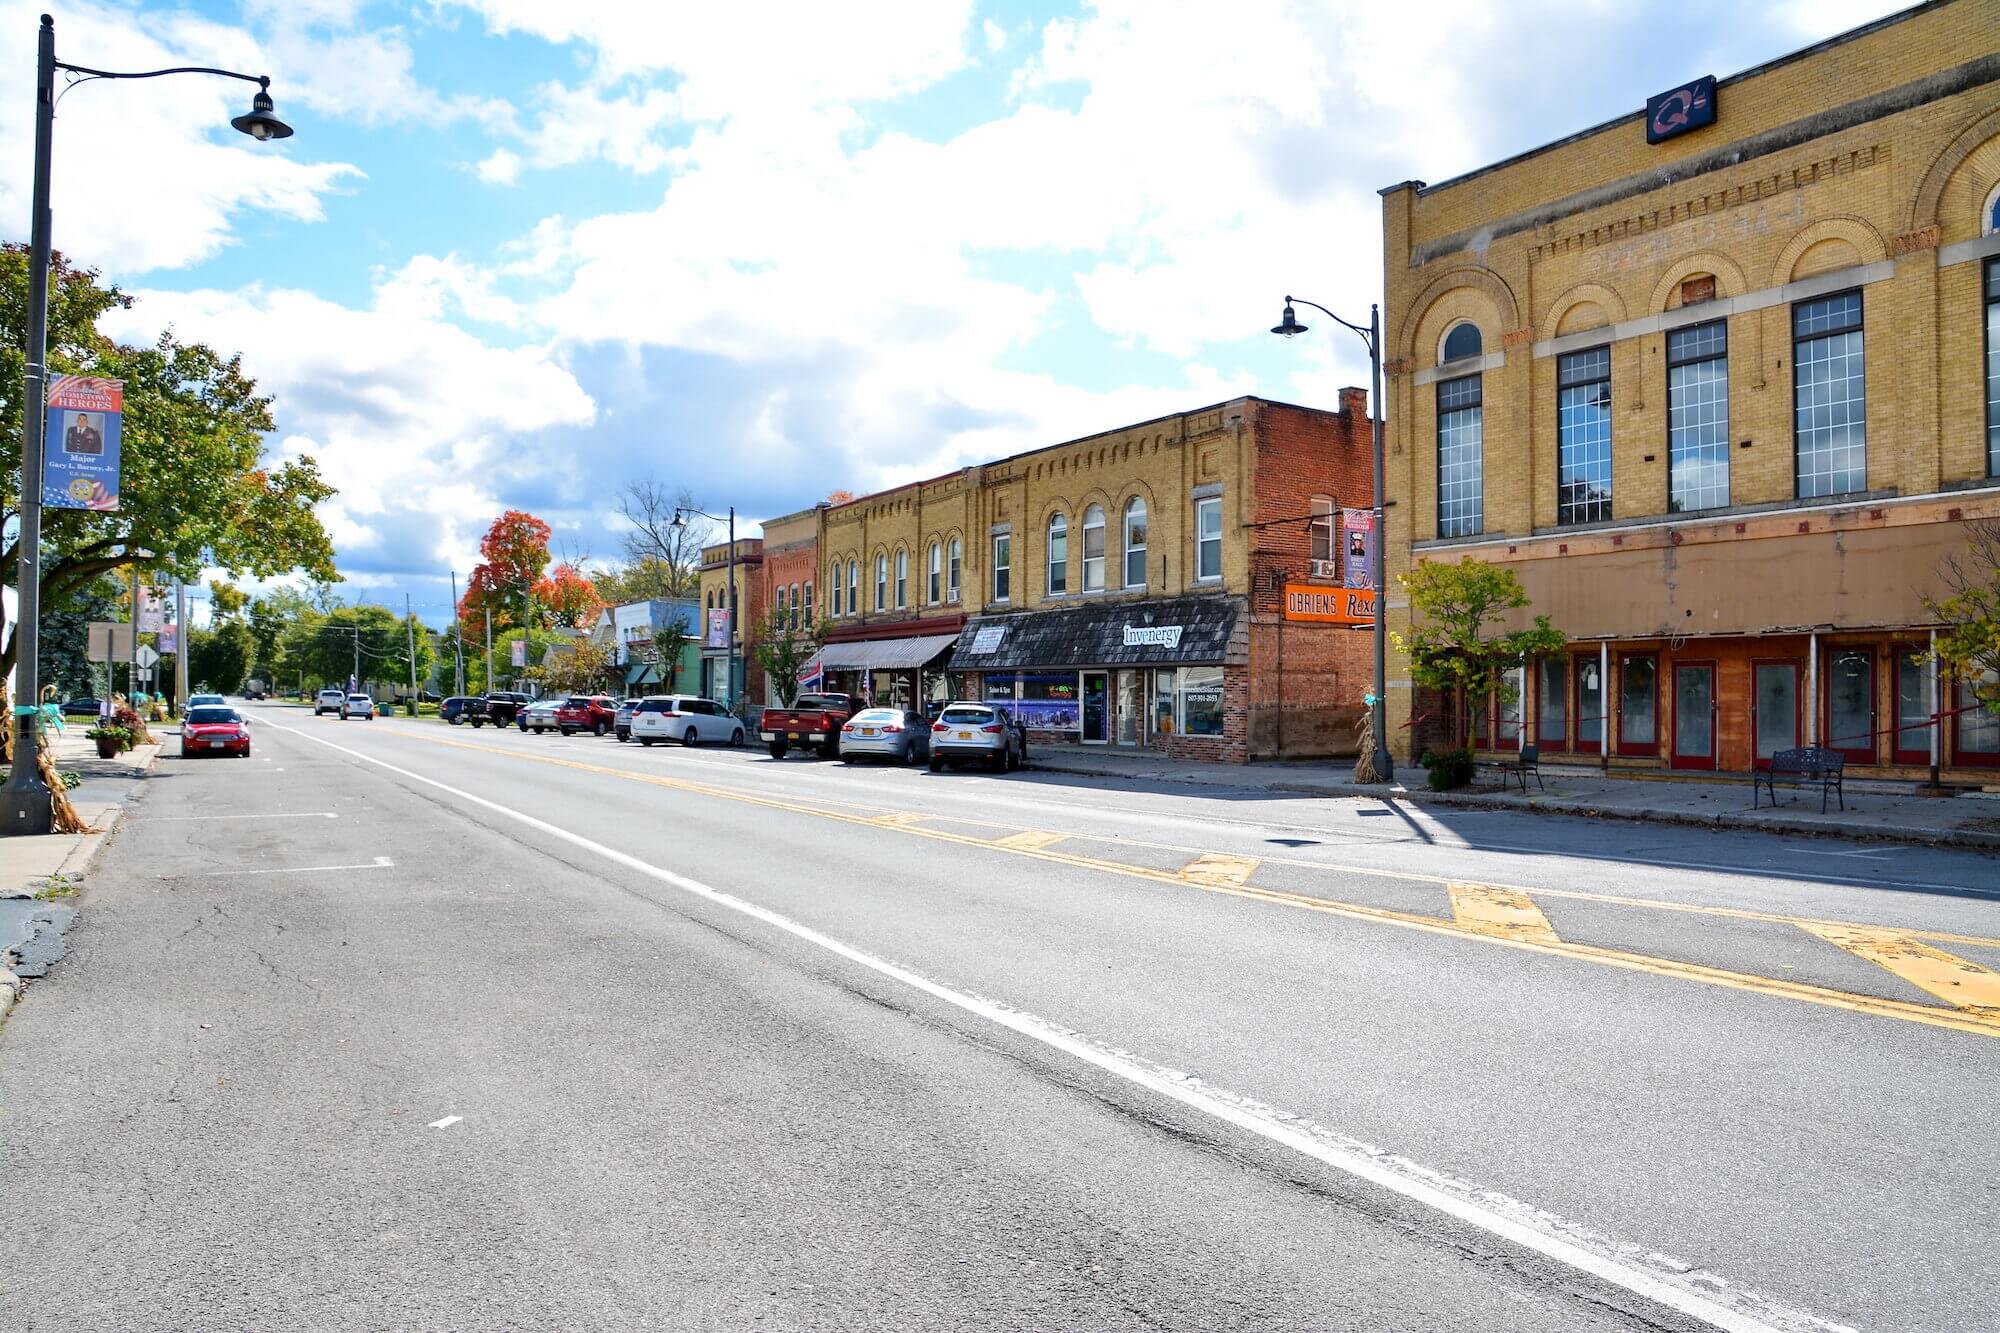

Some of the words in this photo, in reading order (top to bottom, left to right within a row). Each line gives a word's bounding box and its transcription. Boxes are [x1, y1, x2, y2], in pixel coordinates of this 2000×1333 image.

[58, 397, 113, 409] HEROES
[70, 454, 97, 463] Major
[48, 461, 67, 469] Gary
[1289, 593, 1337, 615] OBRIENS
[1125, 627, 1181, 646] Invenergy
